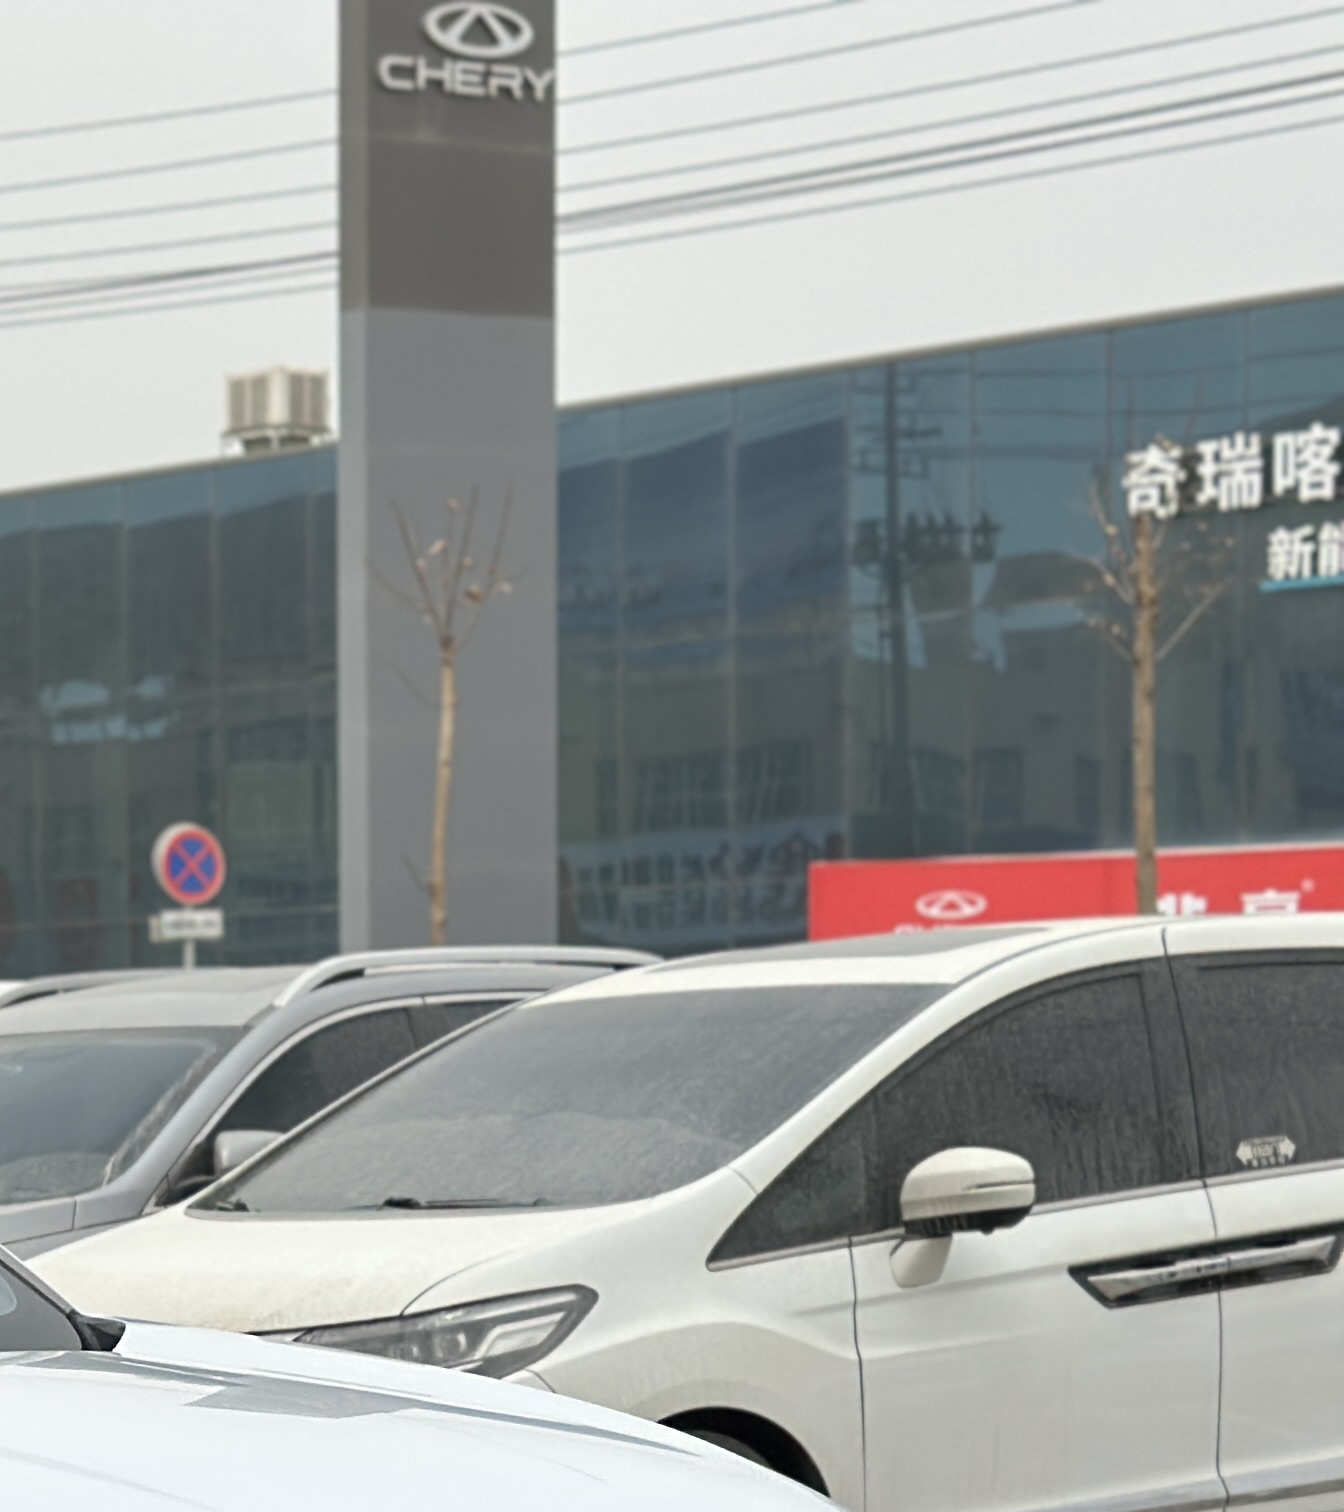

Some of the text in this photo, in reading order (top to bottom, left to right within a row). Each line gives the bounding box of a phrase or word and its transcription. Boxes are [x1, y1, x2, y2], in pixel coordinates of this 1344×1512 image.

[377, 54, 555, 101] CHERY
[1121, 421, 1341, 520] 奇瑞喀
